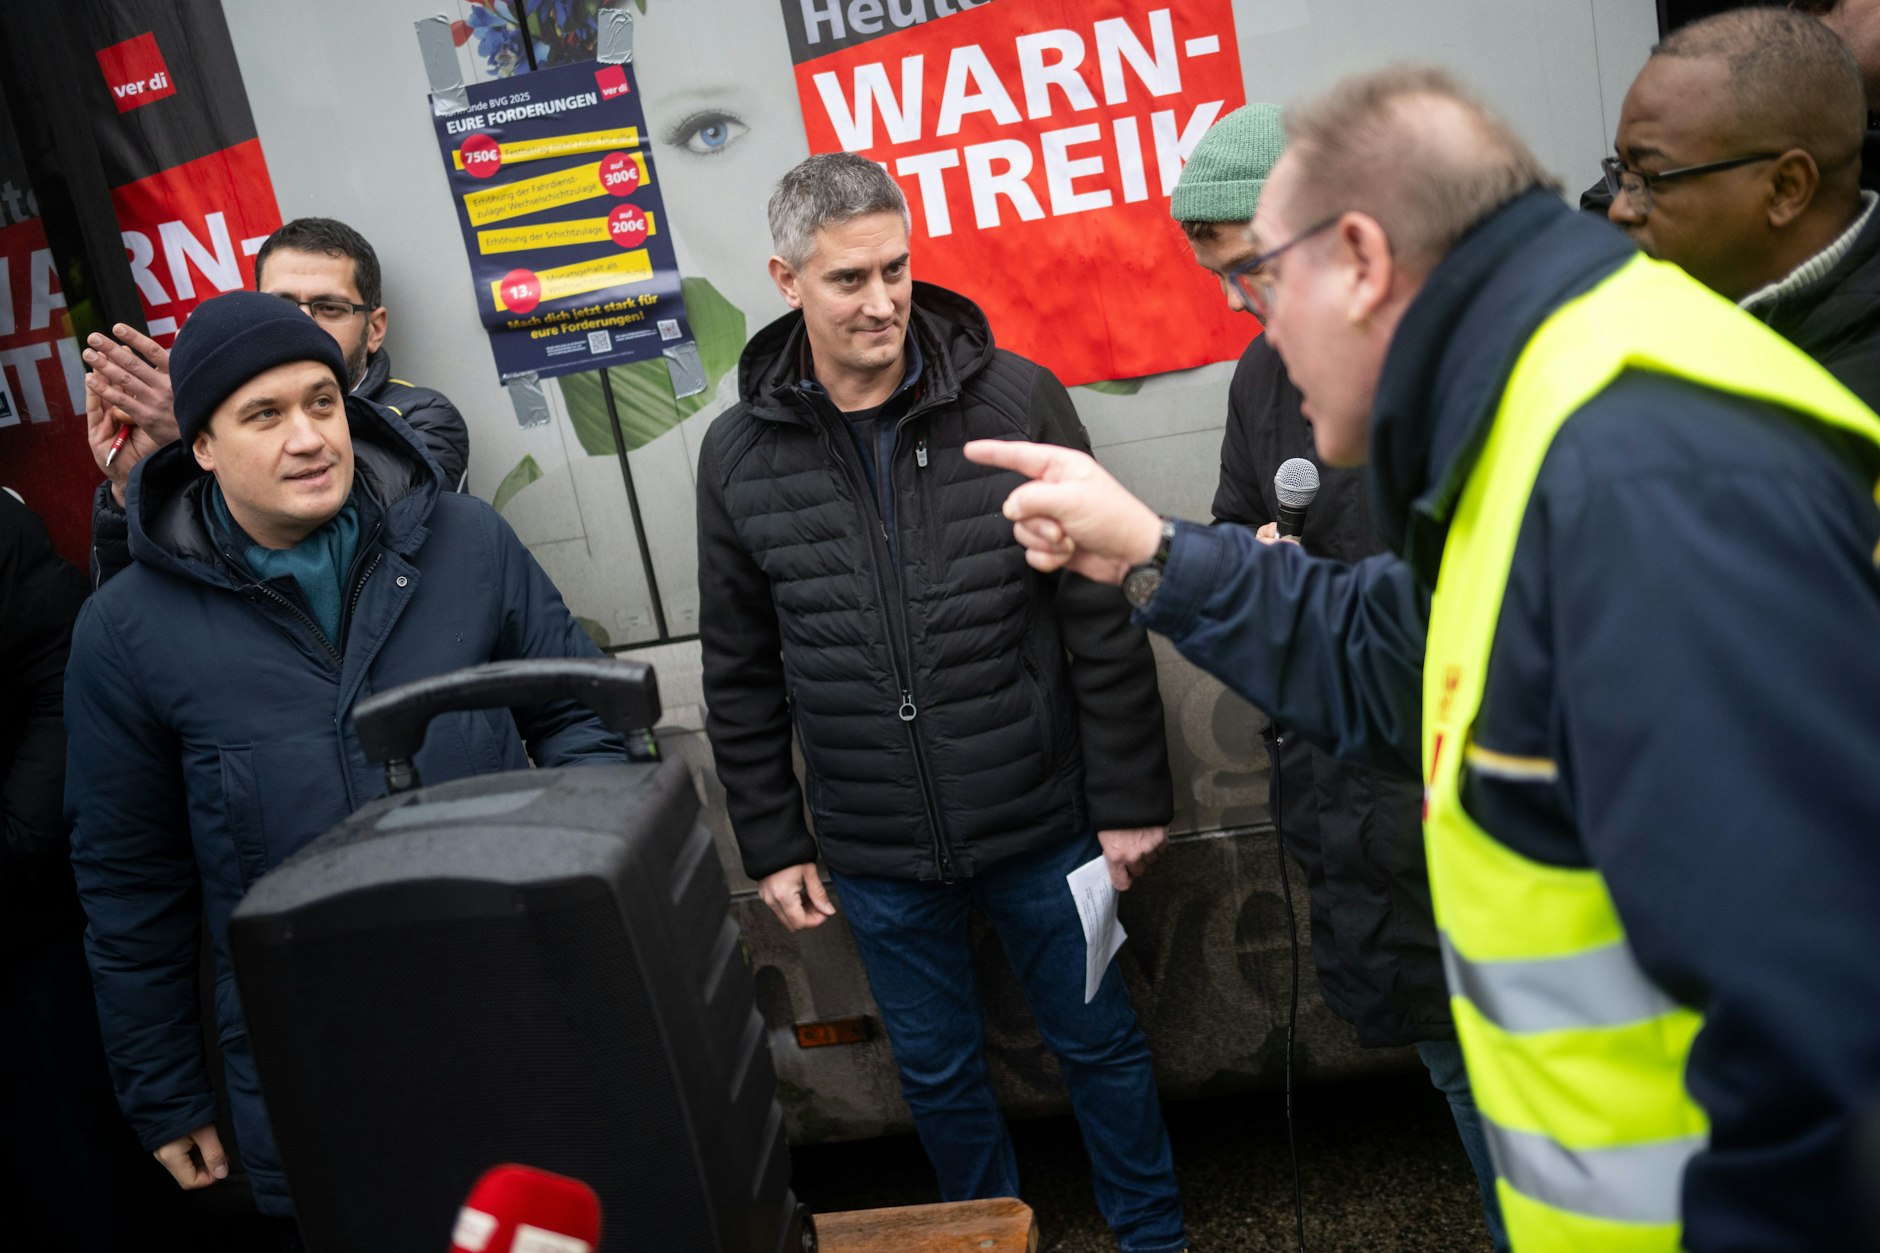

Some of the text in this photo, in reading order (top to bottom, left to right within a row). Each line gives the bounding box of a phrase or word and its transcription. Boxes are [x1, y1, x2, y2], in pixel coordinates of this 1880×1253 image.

[801, 0, 991, 44] Heu
[114, 72, 168, 99] ver.di
[813, 8, 1220, 151] WARN-
[446, 115, 485, 134] EURE
[488, 92, 598, 126] FORDERUNGEN
[489, 92, 531, 108] BVG 2025
[465, 149, 498, 164] 750€
[877, 98, 1225, 237] TREIK
[605, 168, 638, 186] 300€
[473, 189, 515, 207] Erhöhung
[515, 184, 530, 197] der
[508, 183, 597, 211] Wechselschichtzulage
[486, 224, 603, 247] Erhöhung der Schichtzulage
[612, 219, 645, 234] 200€
[510, 284, 533, 299] 13.
[507, 293, 658, 329] Mach dich jetzt stark für
[530, 312, 645, 340] eure Forderungen!
